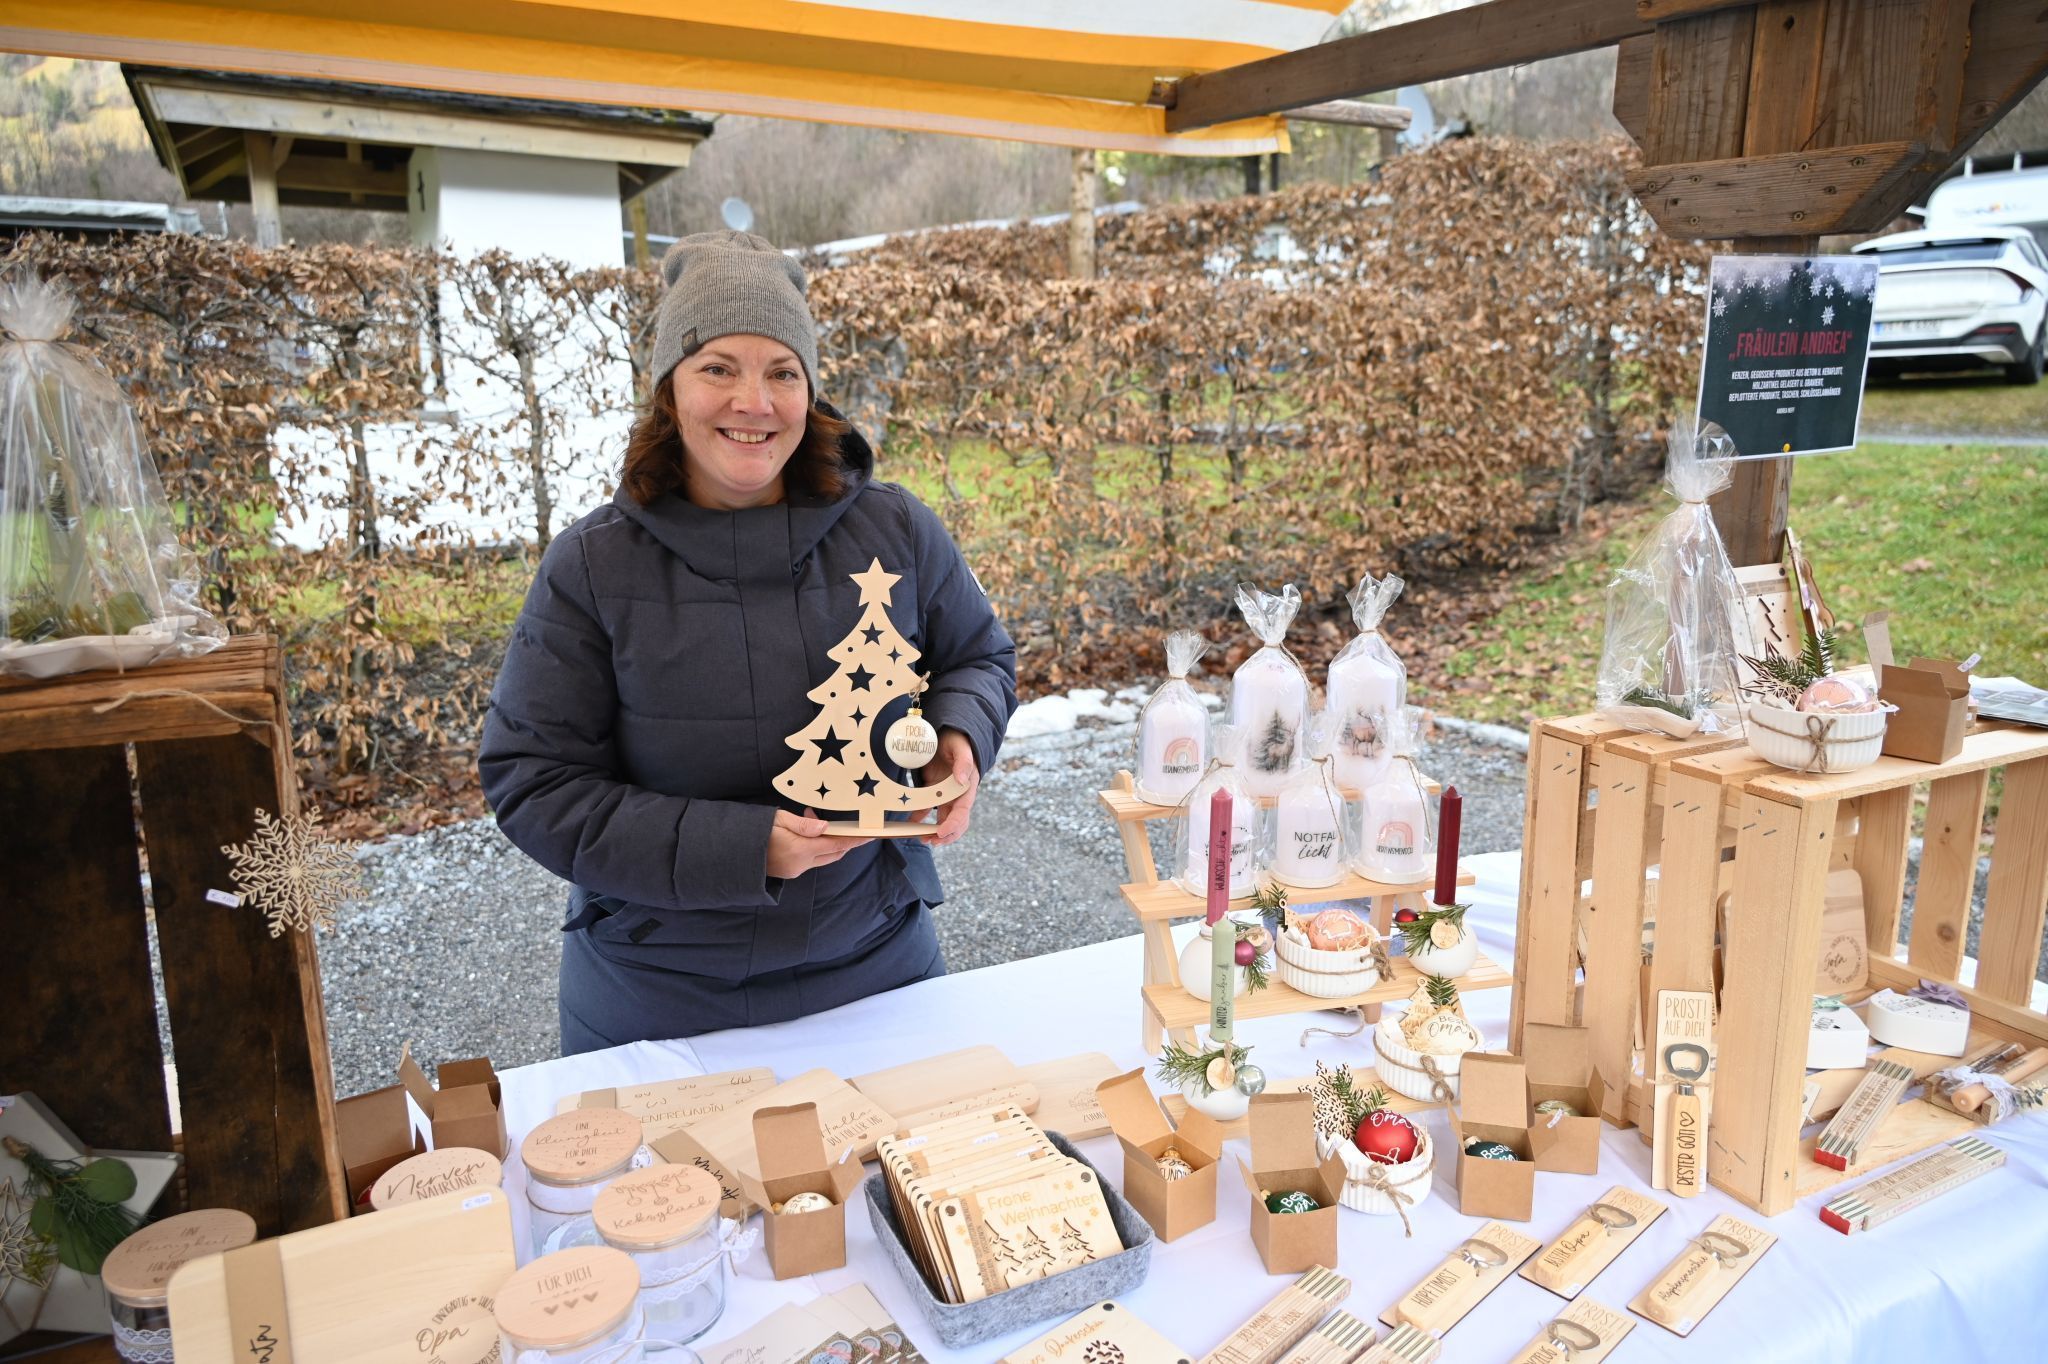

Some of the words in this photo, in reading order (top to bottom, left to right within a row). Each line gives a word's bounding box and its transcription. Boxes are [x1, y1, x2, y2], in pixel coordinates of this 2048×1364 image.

[1665, 997, 1707, 1019] PROST!
[1664, 1021, 1681, 1036] AUF
[1685, 1021, 1706, 1037] DICH
[1371, 1111, 1413, 1129] Oma
[387, 1161, 486, 1201] Nerven
[1676, 1153, 1695, 1186] BESTER
[416, 1173, 477, 1200] NAHRUNG
[1000, 1192, 1102, 1227] Weihnachten
[1720, 1217, 1770, 1245] PROST!
[565, 1265, 592, 1285] DICH
[416, 1327, 470, 1356] Opa
